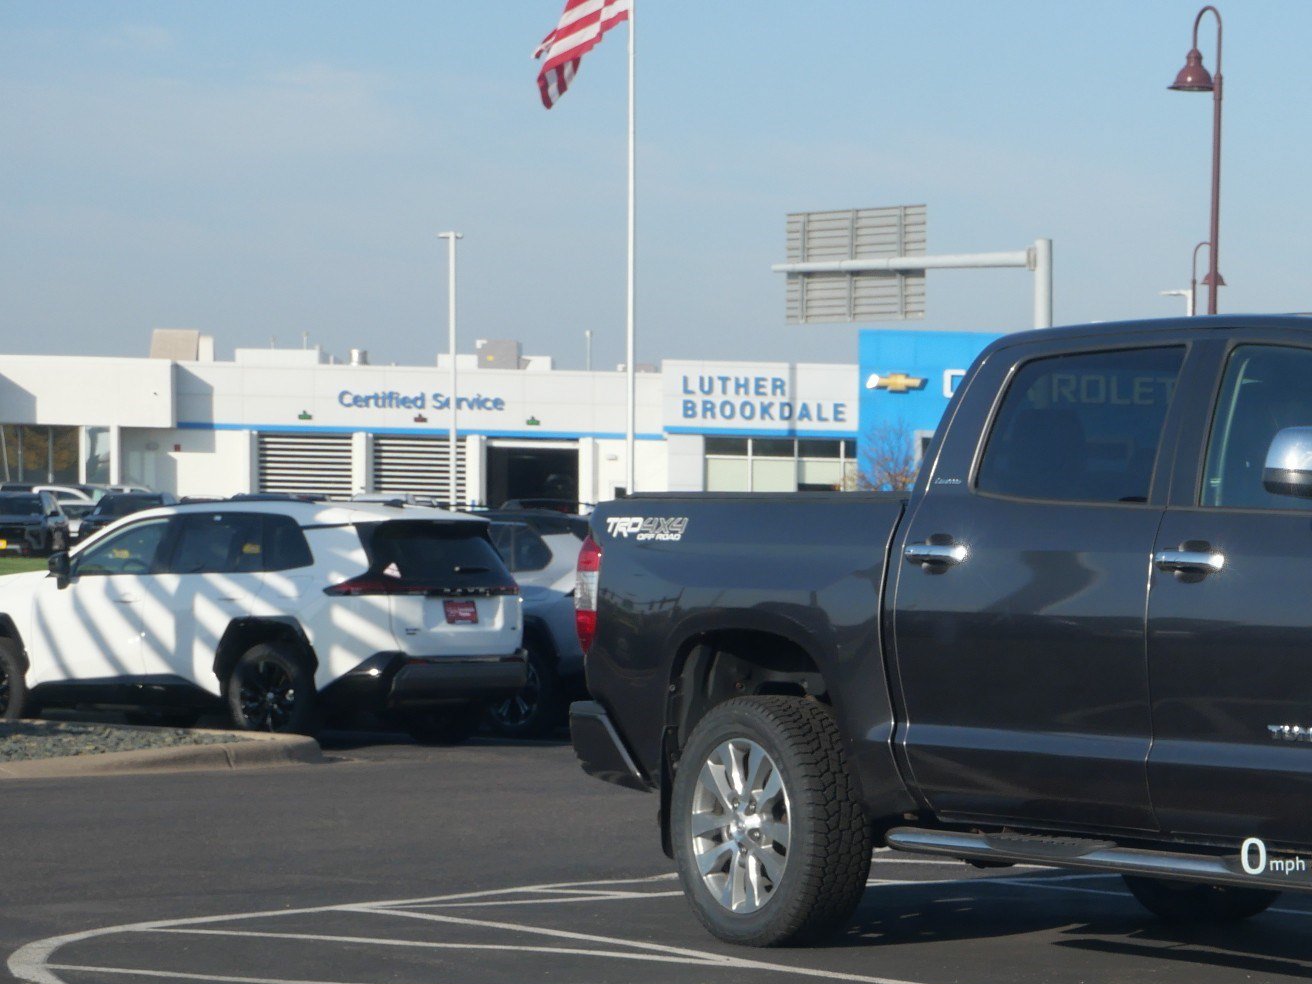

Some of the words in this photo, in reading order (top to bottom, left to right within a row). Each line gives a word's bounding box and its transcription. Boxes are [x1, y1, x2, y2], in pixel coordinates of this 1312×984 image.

[682, 375, 786, 396] LUTHER
[338, 390, 425, 409] Certified
[682, 399, 847, 422] BROOKDALE
[636, 533, 656, 541] OFF
[655, 533, 682, 541] ROAD
[1241, 837, 1267, 875] 0
[1270, 857, 1306, 875] mph
